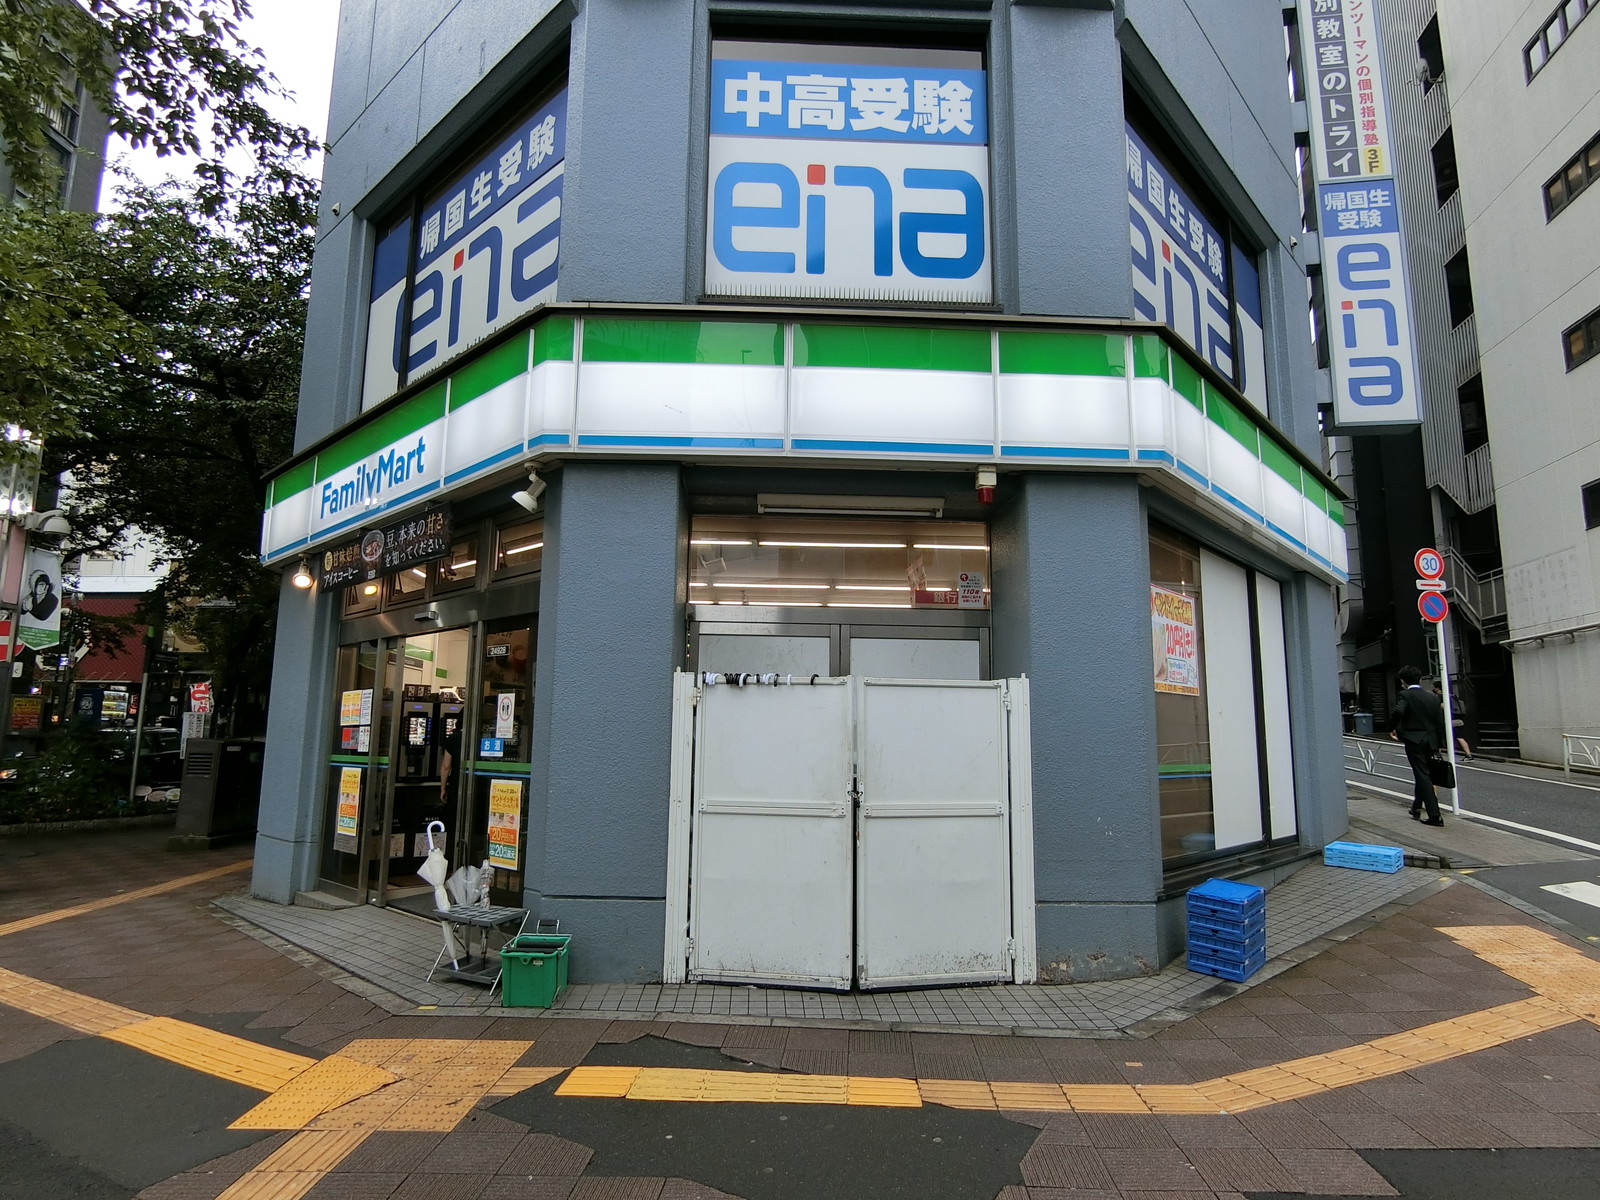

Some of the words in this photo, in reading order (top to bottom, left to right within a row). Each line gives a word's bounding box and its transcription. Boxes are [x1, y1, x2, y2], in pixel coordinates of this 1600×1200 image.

[724, 71, 974, 136] 中高受験
[1367, 149, 1380, 173] 3F
[420, 113, 557, 260] 帰国生受験
[1125, 132, 1224, 283] 帰国生受験
[1324, 188, 1392, 212] 帰国生
[1337, 210, 1383, 231] 受験
[319, 436, 426, 520] FamilyMart
[385, 512, 444, 549] 豆、本来の甘さ
[384, 538, 446, 567] を知ってください。
[1422, 557, 1438, 571] 30
[324, 566, 359, 588] アイスコーヒー
[933, 591, 957, 603] 銀行
